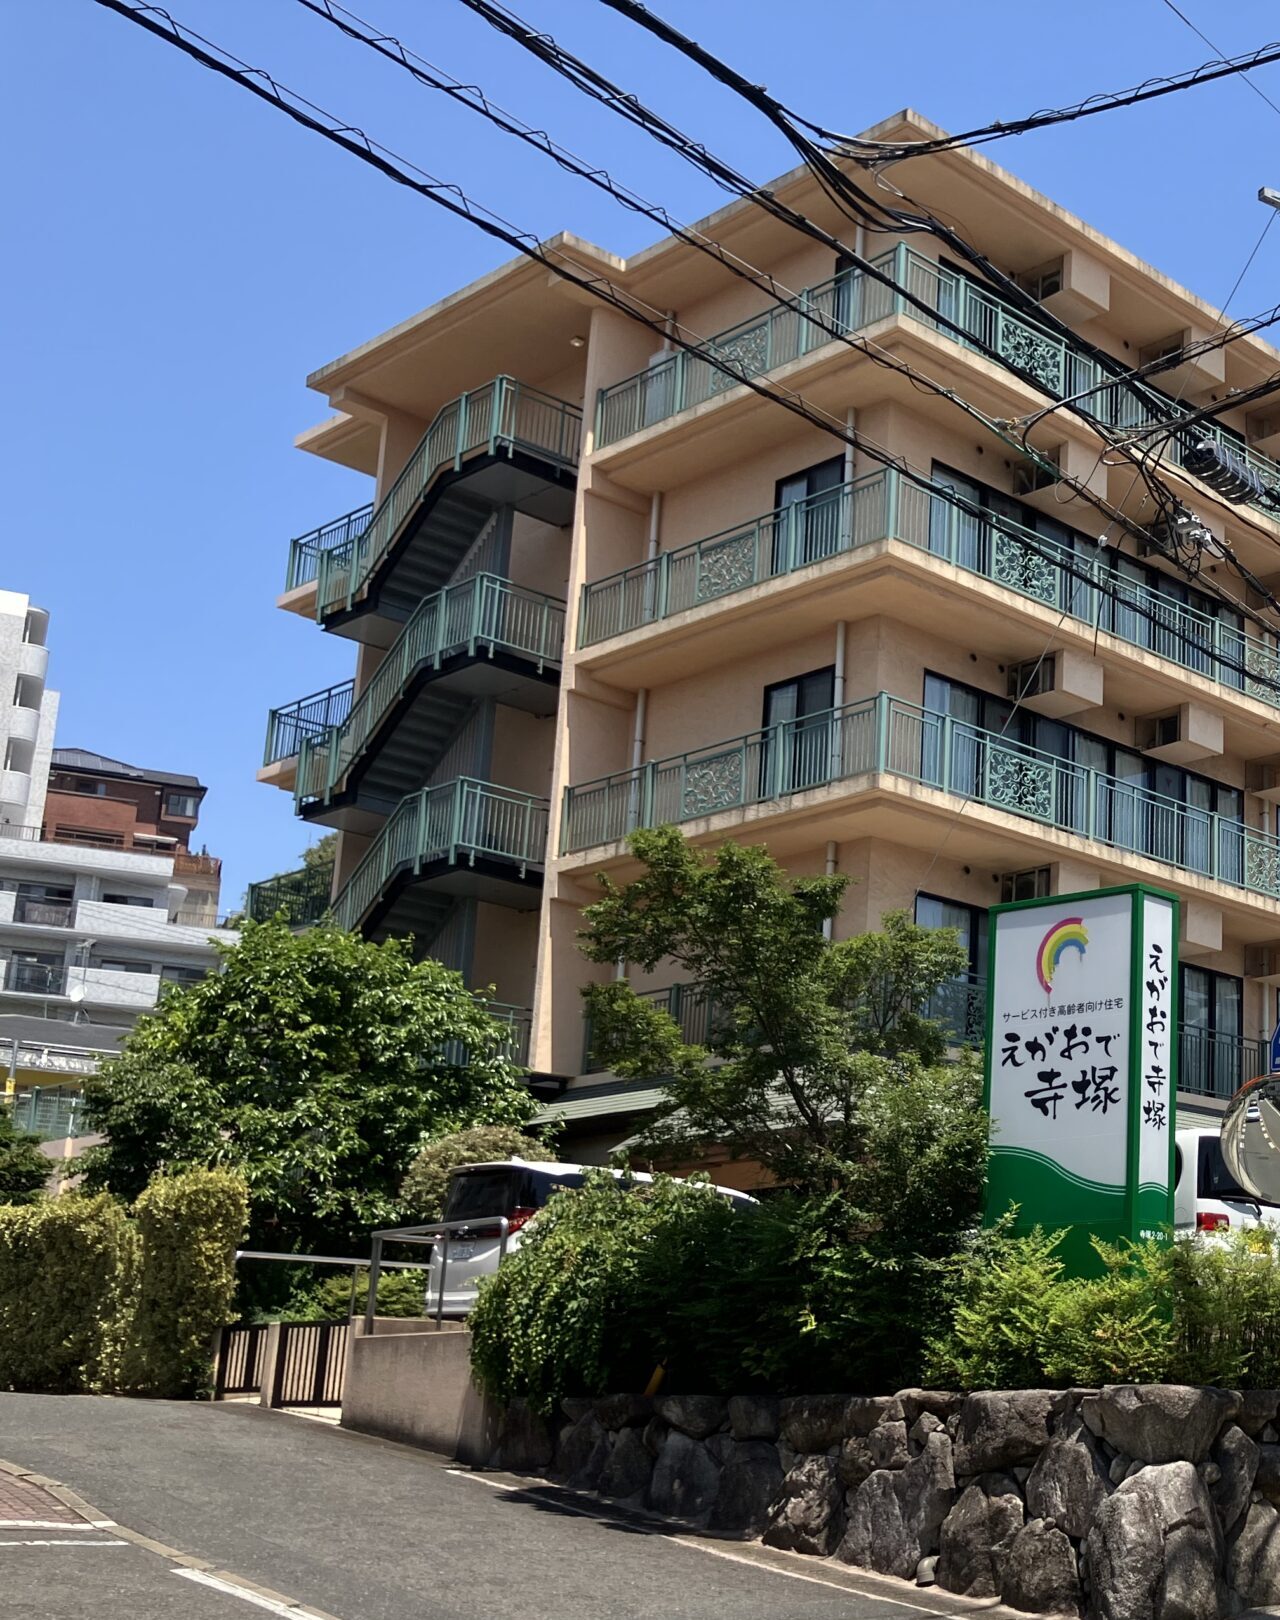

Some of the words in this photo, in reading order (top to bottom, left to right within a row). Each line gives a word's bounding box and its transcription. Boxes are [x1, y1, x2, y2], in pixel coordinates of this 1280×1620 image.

[1002, 997, 1124, 1023] サービス付き高齢者向け住宅
[1001, 1023, 1121, 1067] えがおで
[1143, 943, 1169, 1131] えがおで寺塚
[1024, 1065, 1122, 1120] 寺塚
